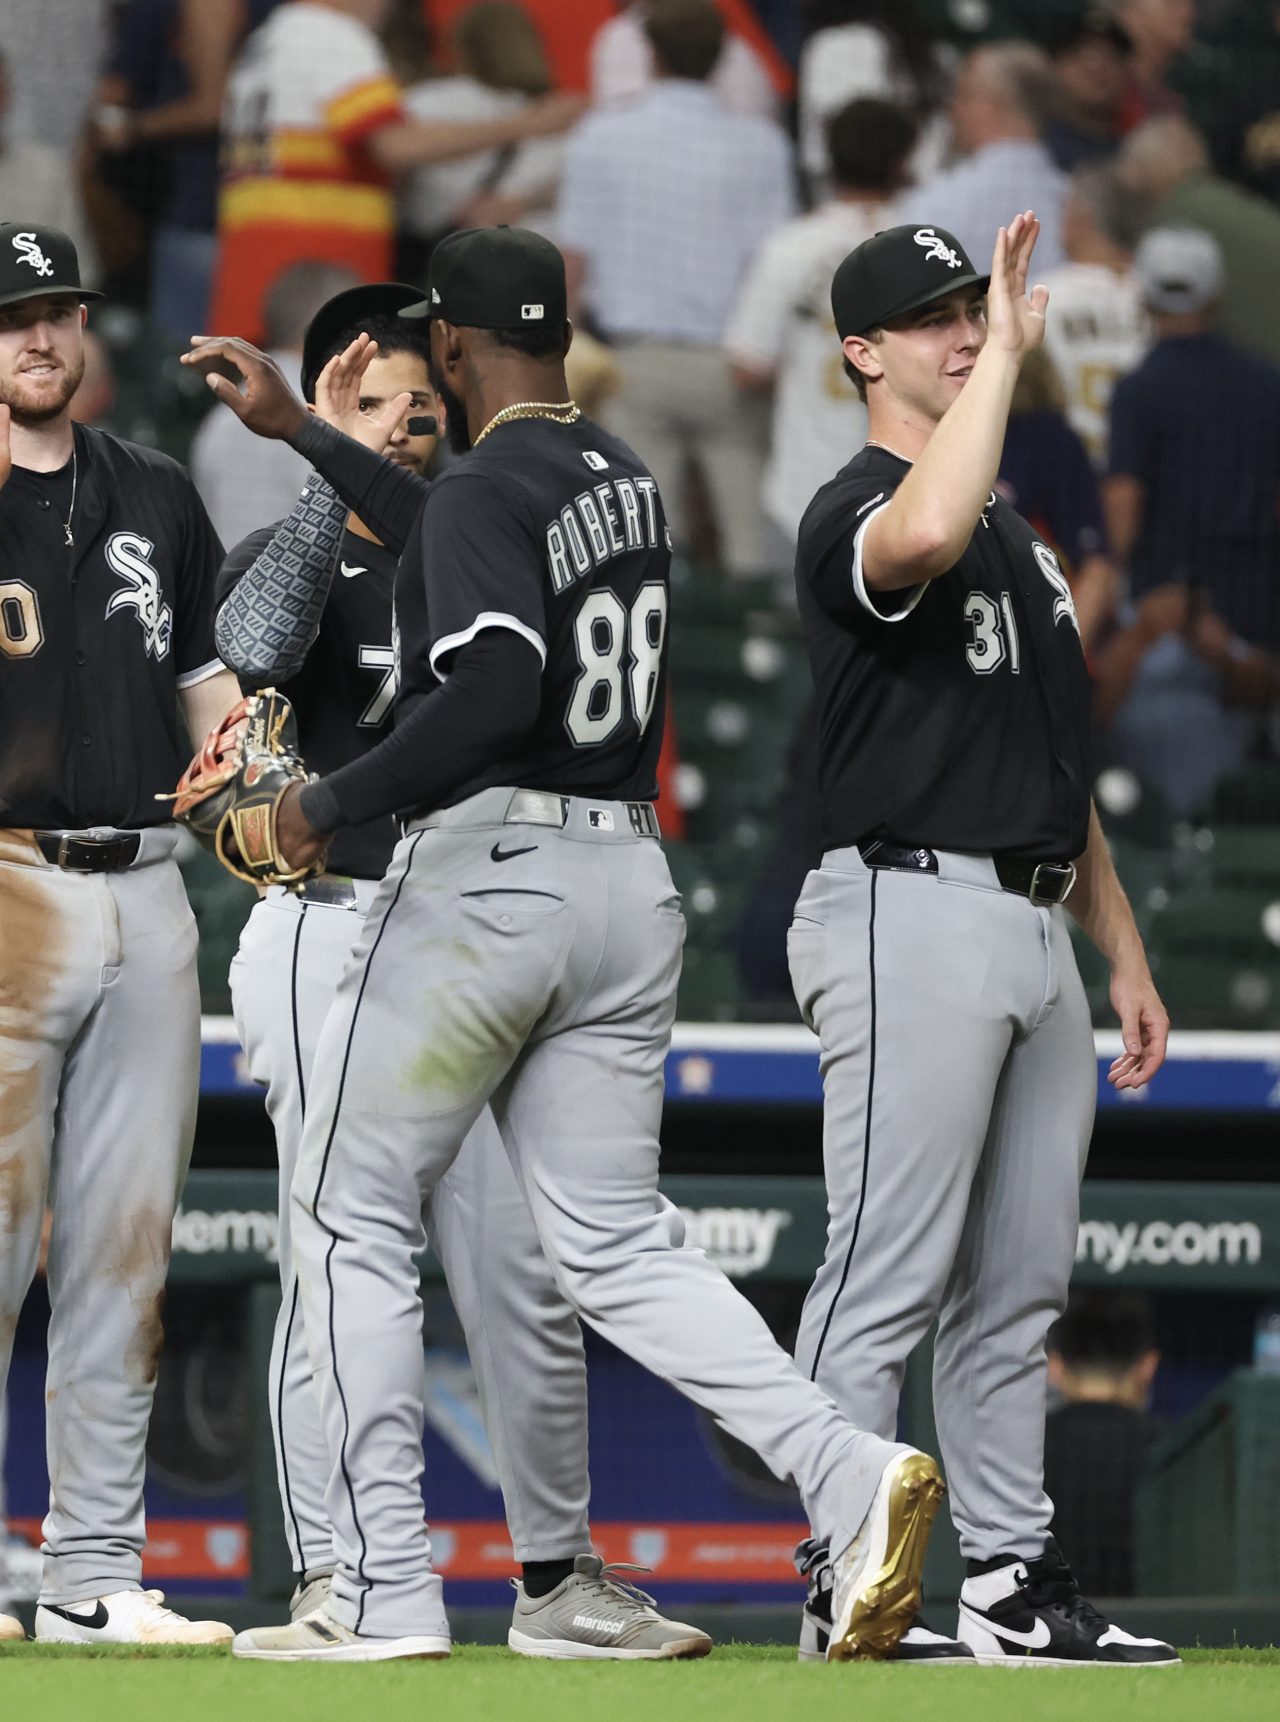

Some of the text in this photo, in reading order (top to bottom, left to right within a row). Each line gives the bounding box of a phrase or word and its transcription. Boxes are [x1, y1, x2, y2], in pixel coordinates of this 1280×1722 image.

[546, 476, 658, 596] ROBERT
[563, 579, 668, 749] 88
[963, 590, 1020, 675] 31
[572, 1614, 625, 1635] marucci
